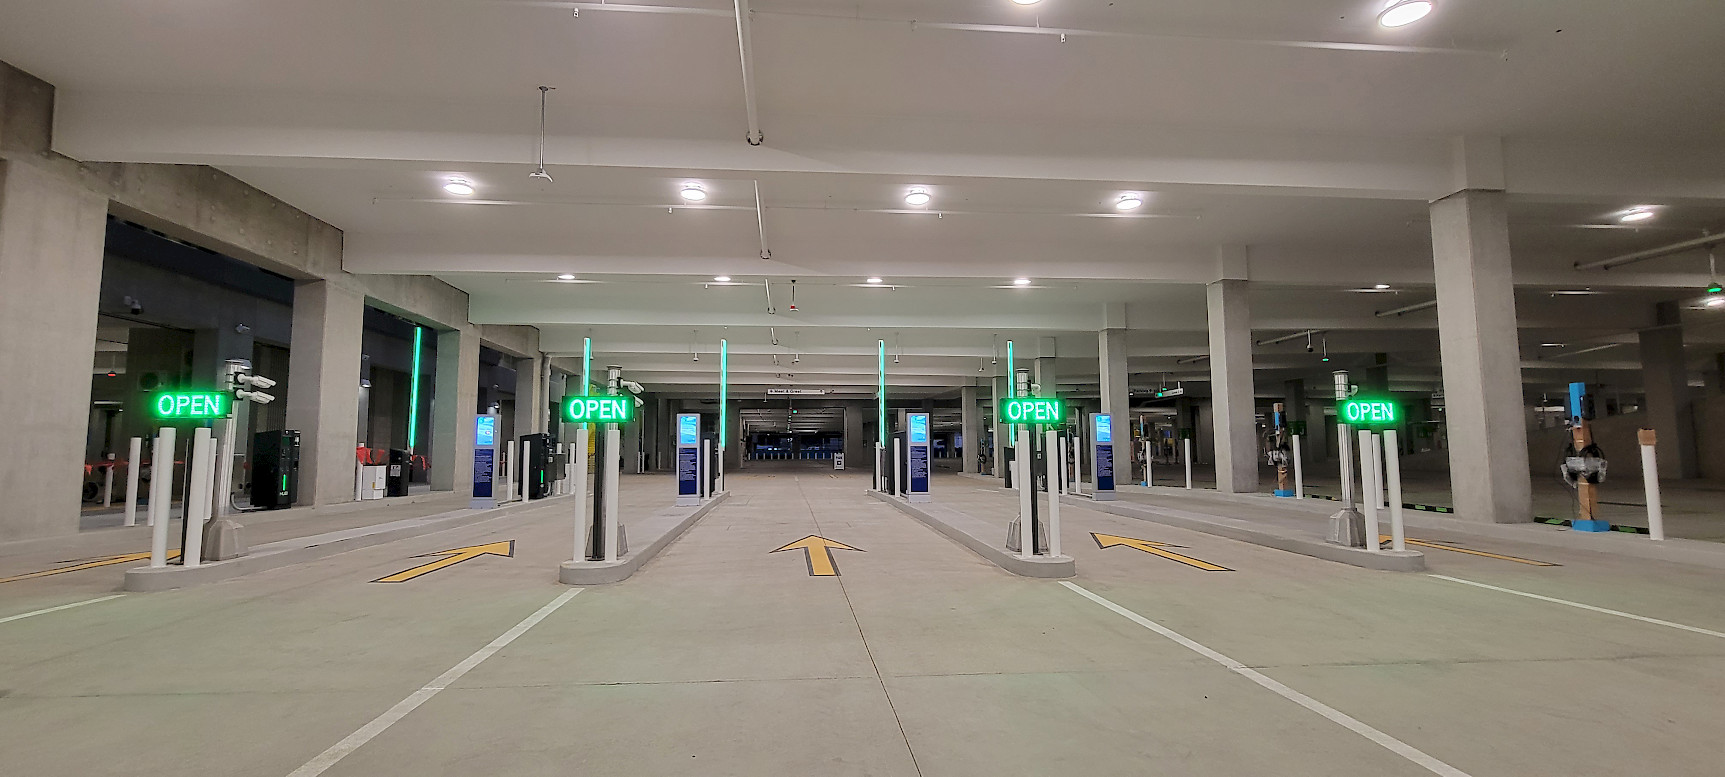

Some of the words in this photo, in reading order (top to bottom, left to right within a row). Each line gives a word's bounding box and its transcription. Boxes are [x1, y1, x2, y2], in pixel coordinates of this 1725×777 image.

[158, 395, 220, 415] OPEN
[569, 399, 627, 420] OPEN
[1008, 401, 1059, 420] OPEN
[1347, 403, 1394, 421] OPEN
